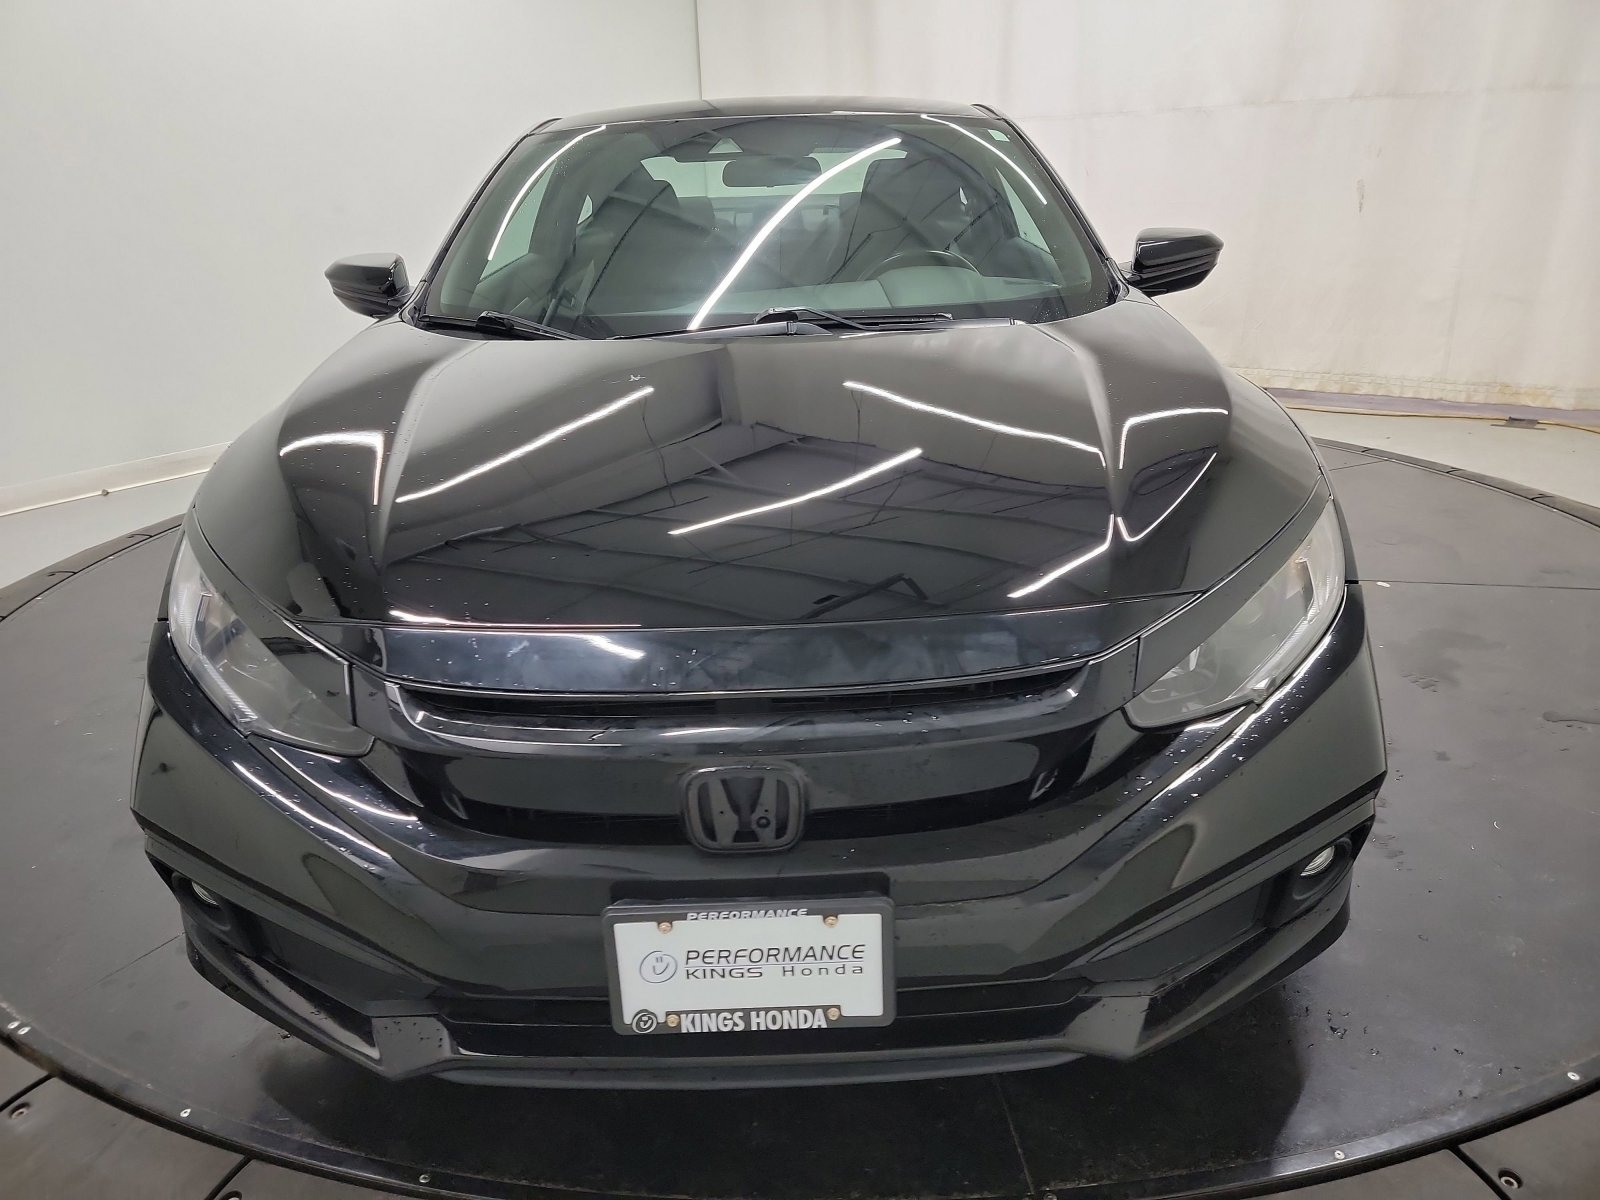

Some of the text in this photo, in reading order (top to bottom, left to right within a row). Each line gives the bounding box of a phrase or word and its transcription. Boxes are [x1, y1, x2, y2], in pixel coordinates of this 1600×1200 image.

[686, 908, 808, 921] PERFORMANCE
[685, 944, 865, 965] PERFORMANCE
[686, 964, 863, 980] KINGS Honda
[680, 1008, 827, 1033] KINGS HONDA
